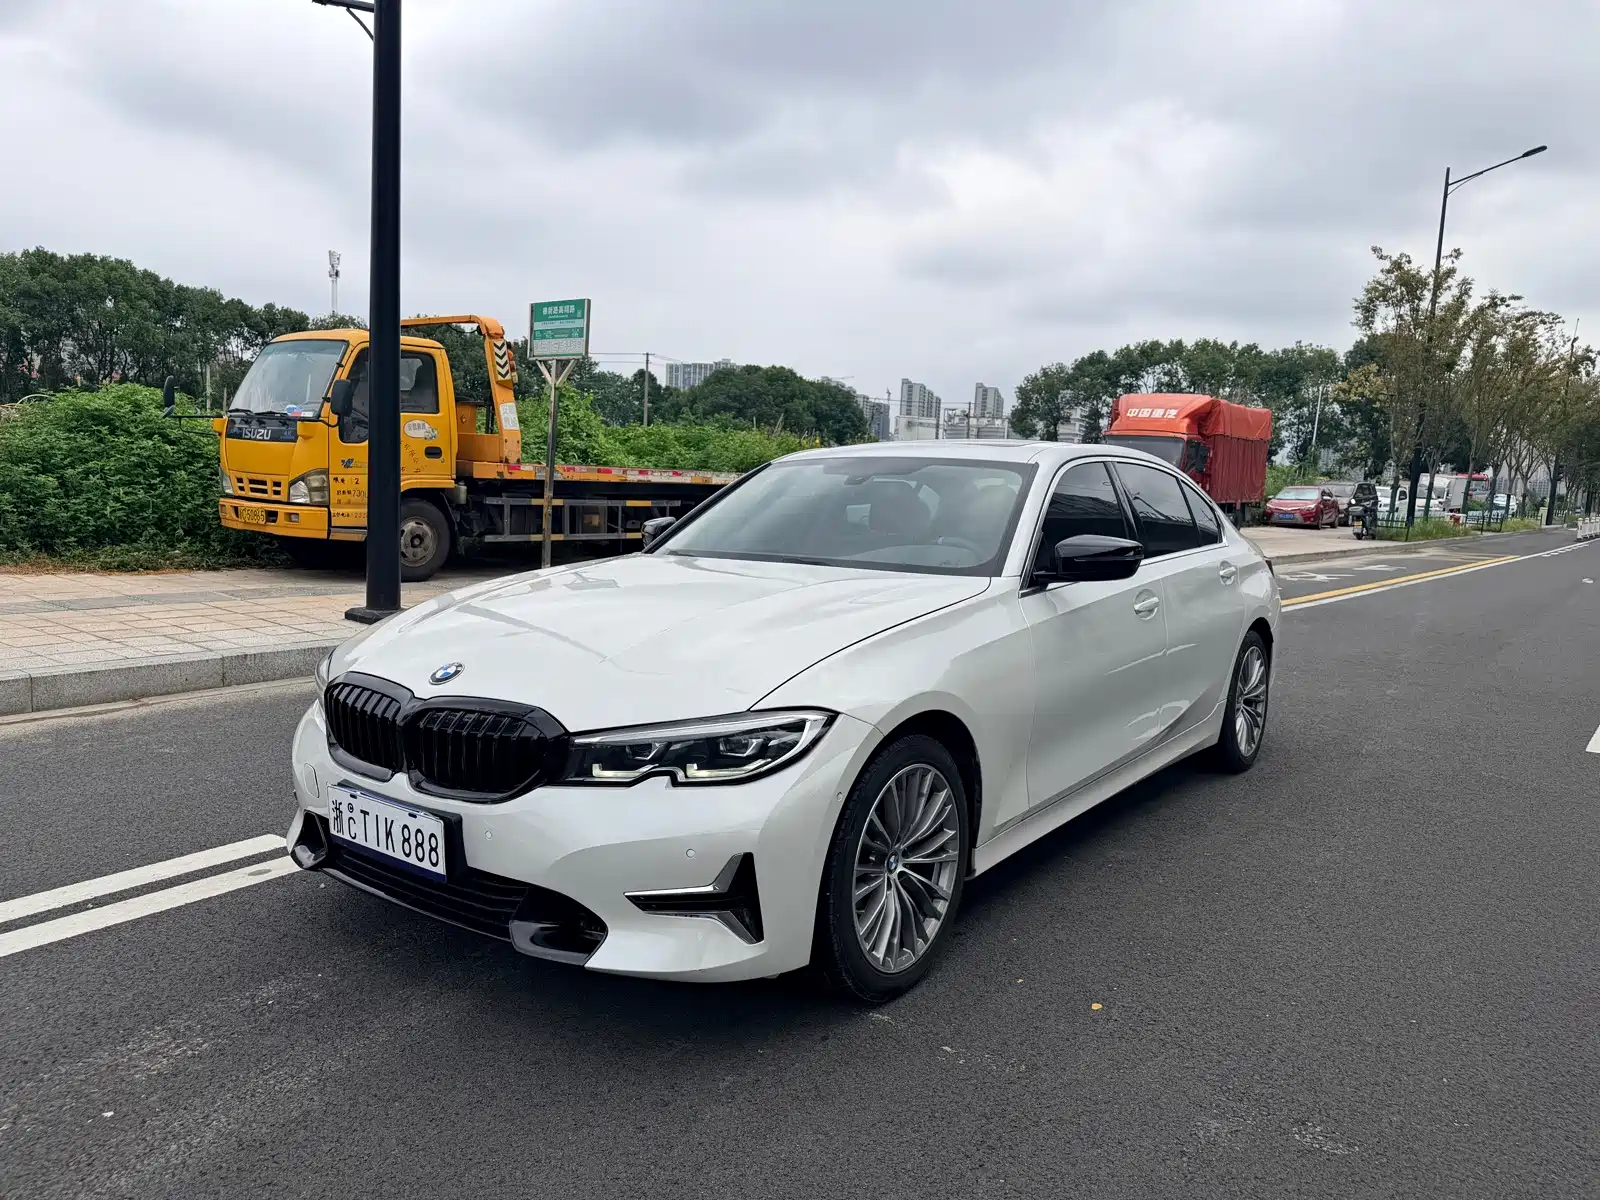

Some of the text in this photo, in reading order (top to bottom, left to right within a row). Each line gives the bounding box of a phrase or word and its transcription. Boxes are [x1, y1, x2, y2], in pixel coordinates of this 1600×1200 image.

[1127, 408, 1178, 418] 中国重汽
[242, 427, 272, 440] ISUZU
